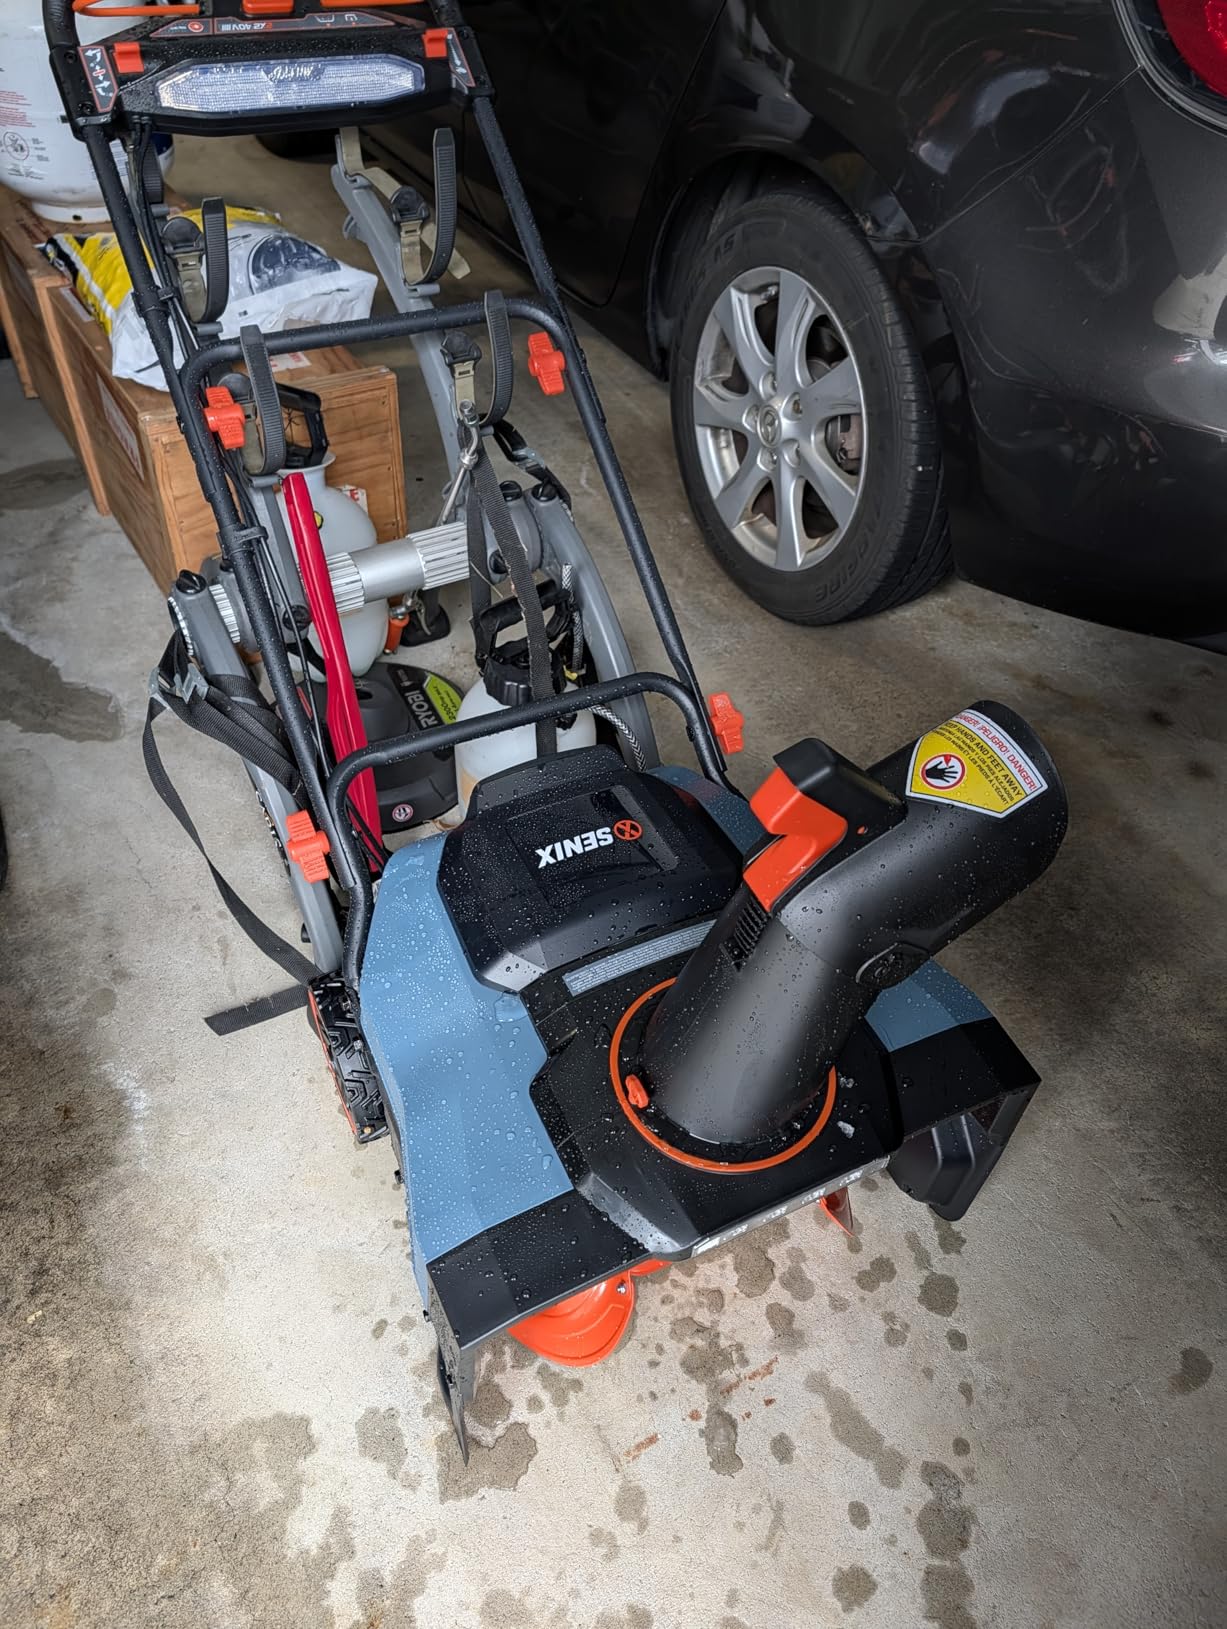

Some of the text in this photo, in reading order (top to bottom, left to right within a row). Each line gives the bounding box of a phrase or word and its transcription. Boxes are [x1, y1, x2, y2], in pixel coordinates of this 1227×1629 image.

[404, 690, 438, 728] RYOBI
[956, 726, 977, 742] HANDS
[974, 742, 990, 756] AND
[987, 754, 1005, 773] FEET
[1001, 773, 1023, 797] AWAY
[1007, 754, 1037, 791] DANGER!
[534, 826, 614, 869] SENIX
